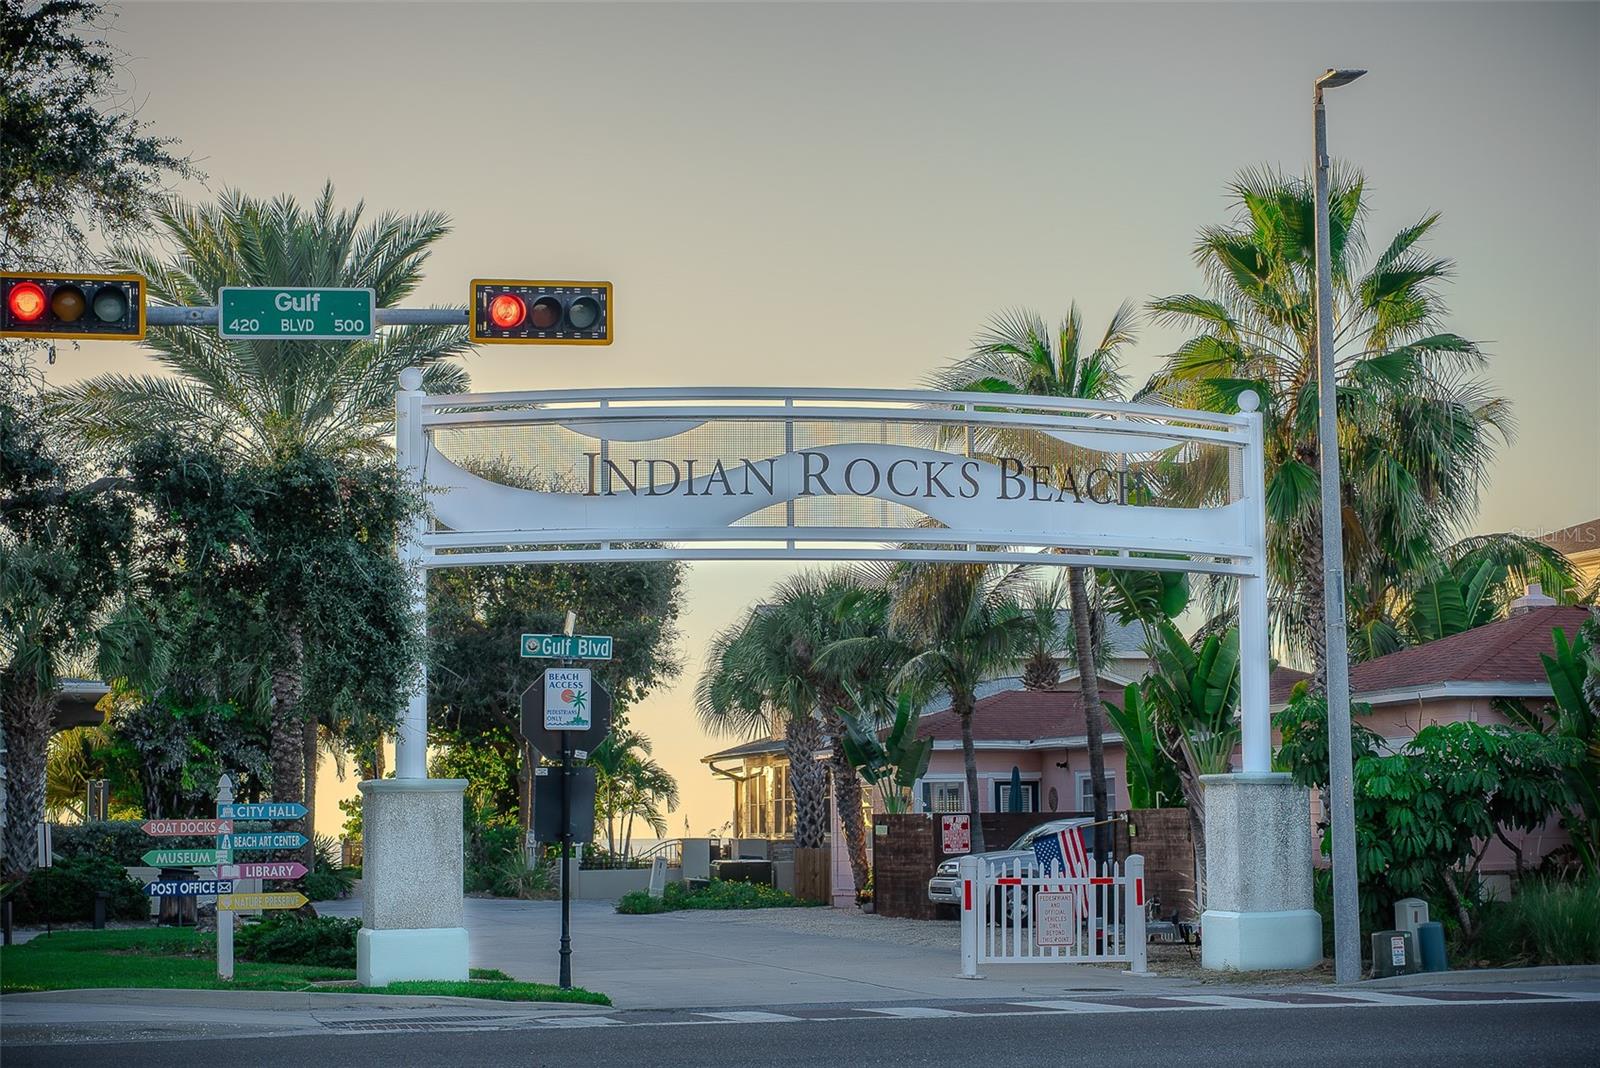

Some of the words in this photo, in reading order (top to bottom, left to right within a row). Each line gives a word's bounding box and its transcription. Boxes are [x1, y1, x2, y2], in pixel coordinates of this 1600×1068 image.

[274, 292, 320, 312] Gulf
[228, 318, 260, 332] 420
[280, 319, 315, 332] BLVD
[334, 319, 365, 332] 500
[542, 638, 571, 655] Gulf
[578, 639, 609, 656] Blvd
[548, 681, 584, 689] ACCESS
[237, 807, 265, 817] CITY
[269, 807, 298, 817] HALL
[150, 822, 177, 833] BOAT
[180, 822, 217, 833] DOCKS
[234, 837, 256, 847] BEACH
[258, 837, 273, 847] ART
[274, 837, 301, 847] CENTER
[156, 853, 211, 863] MUSEUM
[245, 866, 294, 877] LIBRARY
[151, 883, 178, 895] POST
[180, 882, 216, 894] OFFICE
[234, 896, 263, 907] NATURE
[265, 895, 300, 906] PRESERVE
